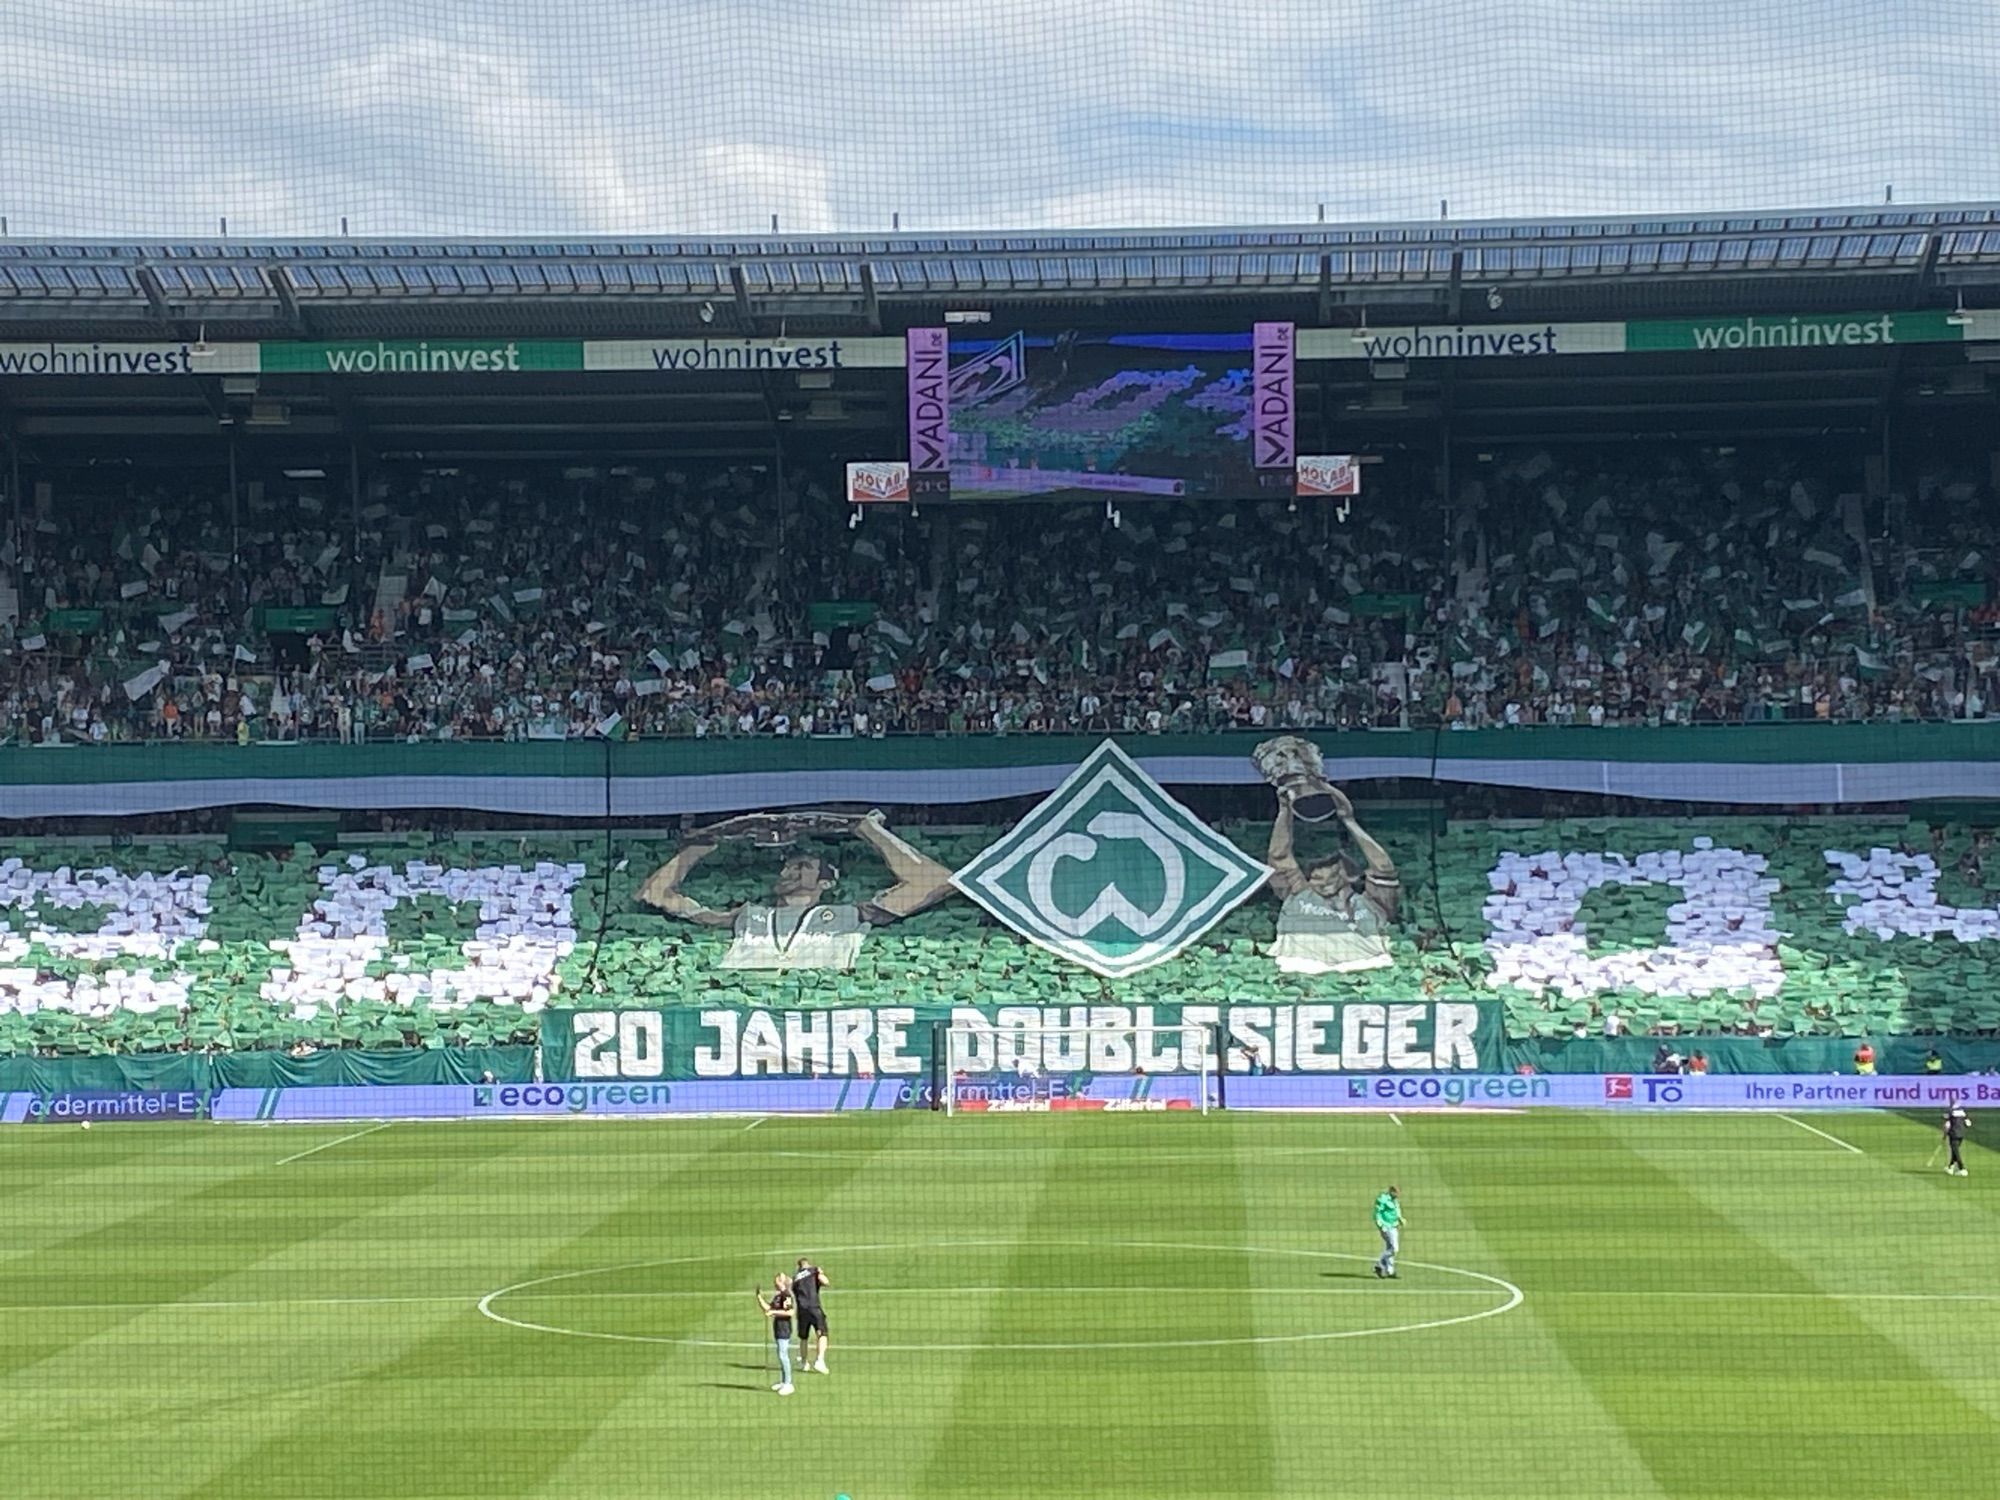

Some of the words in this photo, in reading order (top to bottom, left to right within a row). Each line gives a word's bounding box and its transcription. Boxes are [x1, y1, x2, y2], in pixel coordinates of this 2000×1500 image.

[1363, 325, 1557, 357] wohninvest
[1693, 314, 1895, 350] wohninvest
[0, 344, 194, 374] wohninvest
[326, 342, 520, 372] wohninvest
[653, 339, 843, 370] wohninvest
[573, 1010, 663, 1077] 20
[694, 1007, 922, 1077] JAHRE
[950, 1002, 1479, 1074] DOUBLESIEGER
[499, 1084, 672, 1112] ecogreen
[1374, 1077, 1550, 1105] ecogreen
[1745, 1083, 1786, 1100] Ihre
[1792, 1082, 1867, 1101] Partner
[1873, 1082, 1921, 1100] rund
[1927, 1086, 1970, 1101] ums
